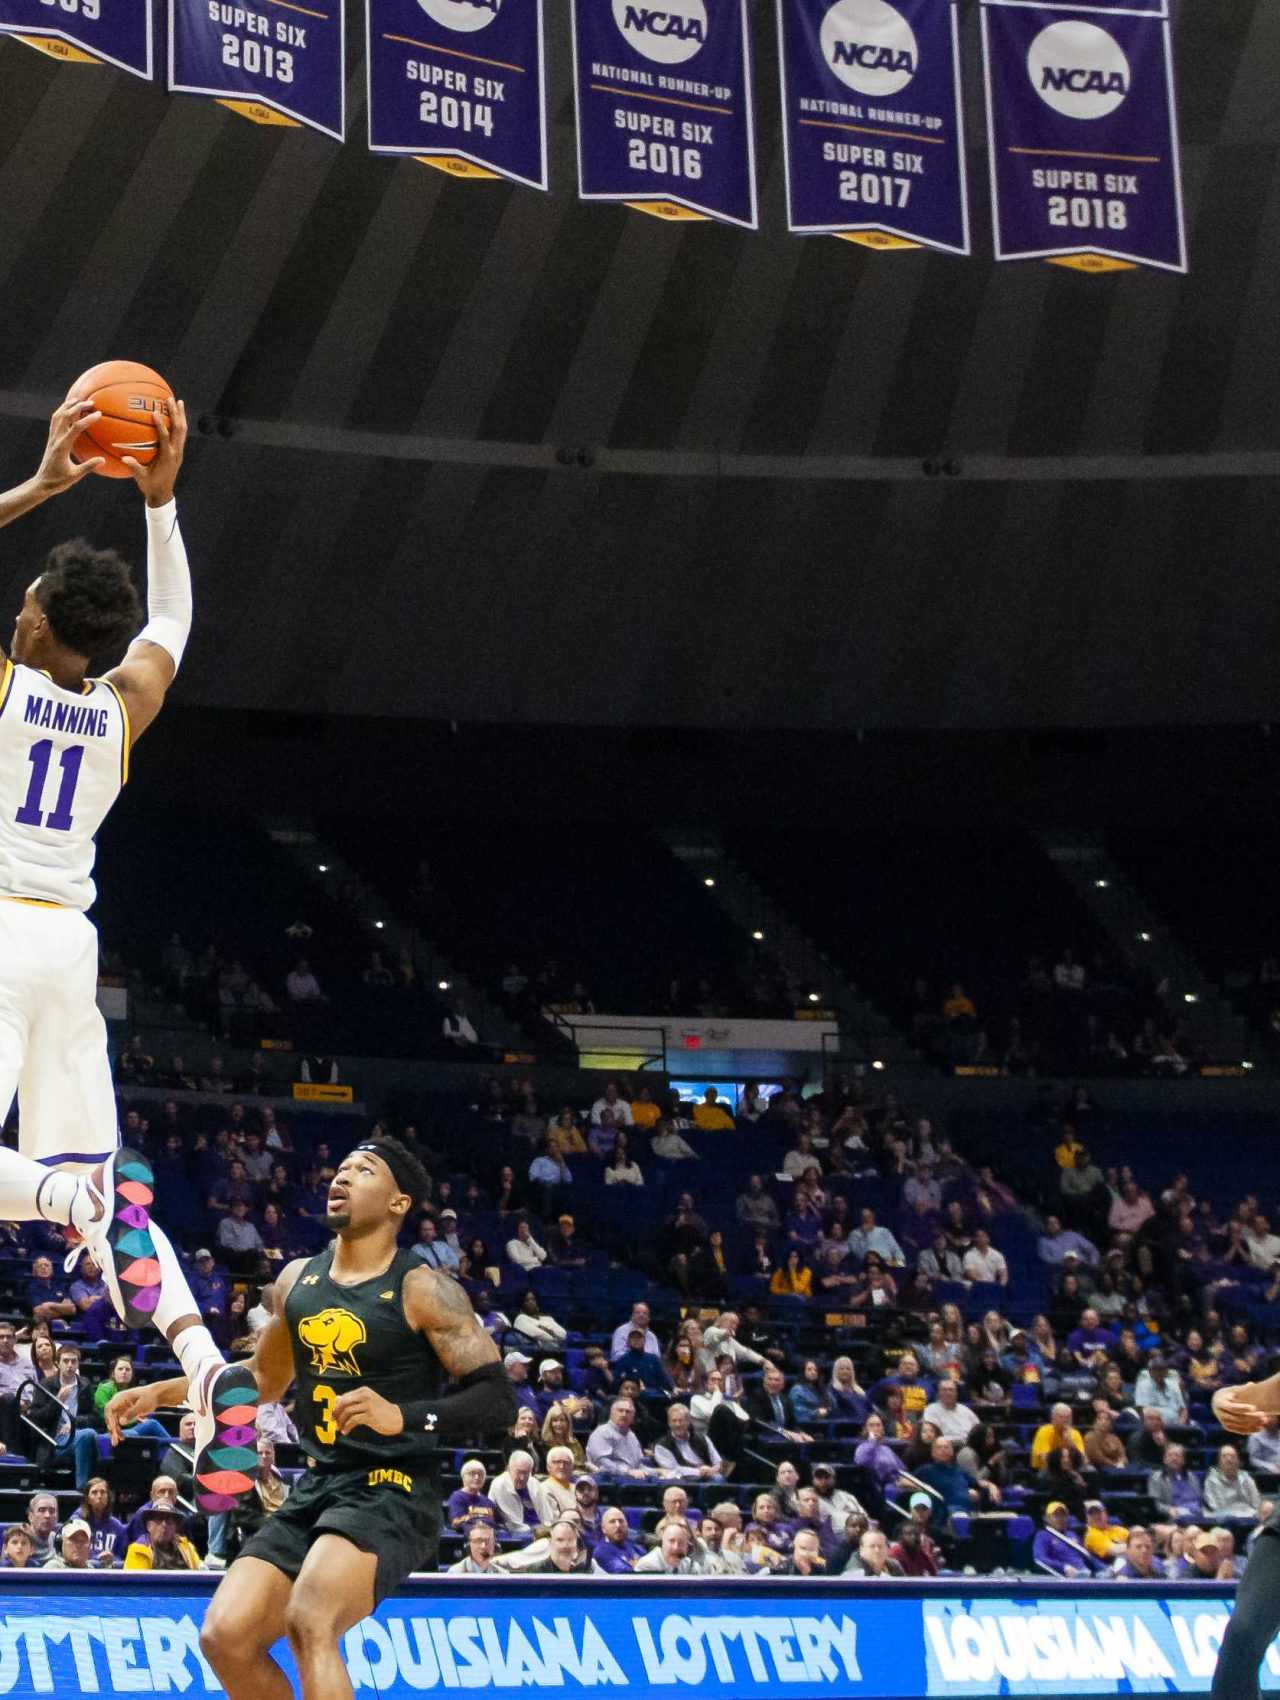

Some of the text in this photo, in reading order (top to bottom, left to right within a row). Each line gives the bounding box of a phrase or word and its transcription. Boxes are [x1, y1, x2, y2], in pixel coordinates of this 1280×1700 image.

[208, 1, 307, 49] SUPER SIX
[623, 6, 705, 43] NCAA
[222, 34, 294, 83] 2013
[832, 40, 915, 76] NCAA
[406, 59, 505, 101] SUPER SIX
[591, 62, 732, 101] NATIONAL RUNNER-UP
[1040, 66, 1126, 96] NCAA
[420, 91, 493, 137] 2014
[614, 109, 714, 145] SUPER SIX
[800, 97, 863, 119] NATIONAL
[628, 138, 703, 180] 2016
[823, 141, 924, 174] SUPER SIX
[838, 170, 911, 209] 2017
[1032, 168, 1139, 195] SUPER SIX
[1048, 196, 1128, 231] 2018
[24, 694, 108, 738] MANNING
[15, 739, 85, 831] 11
[313, 1384, 337, 1445] 3
[367, 1468, 413, 1493] UMBC
[344, 1613, 863, 1690] OUISIANA LOTTERY
[923, 1612, 1177, 1681] LOUISIANA
